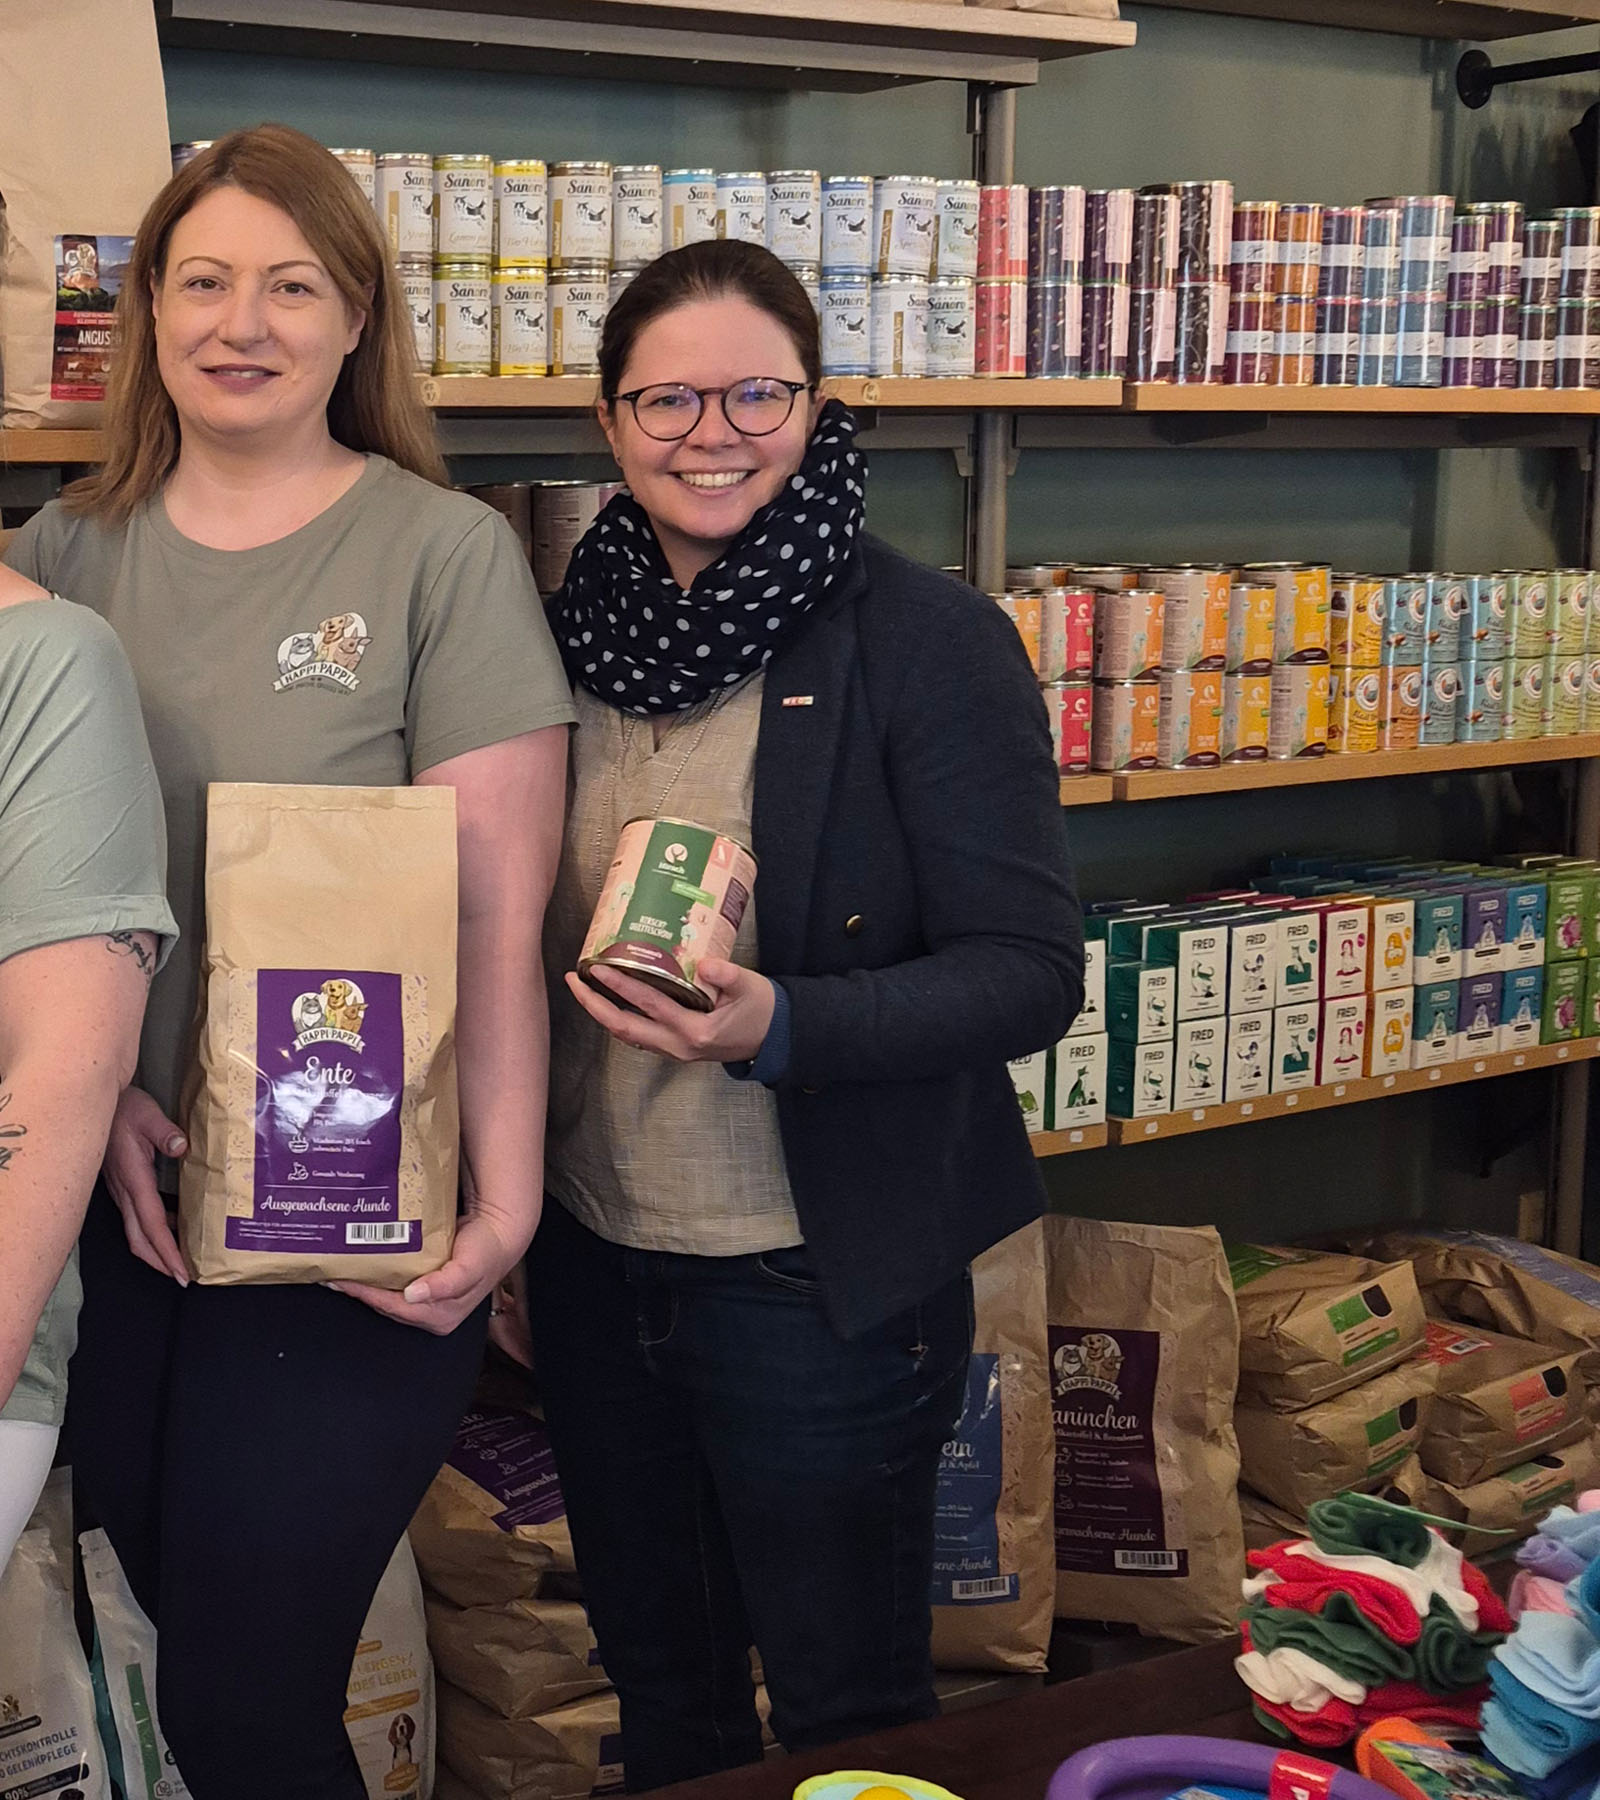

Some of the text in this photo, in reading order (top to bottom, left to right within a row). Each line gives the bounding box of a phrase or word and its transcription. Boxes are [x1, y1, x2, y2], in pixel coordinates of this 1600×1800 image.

[78, 330, 111, 346] ANGUS
[284, 663, 352, 684] HAPPI PAPPI
[1385, 912, 1406, 924] FRED
[1287, 925, 1309, 937] FRED
[1337, 919, 1358, 931] FRED
[1192, 938, 1216, 950] FRED
[1245, 934, 1267, 946] FRED
[1147, 977, 1167, 987] FRED
[1385, 998, 1406, 1011] FRED
[1336, 1006, 1358, 1019] FRED
[1287, 1014, 1309, 1026] FRED
[1239, 1021, 1262, 1033] FRED
[302, 1029, 358, 1045] HAPPI PAPPI
[1190, 1028, 1215, 1041] FRED
[1069, 1045, 1096, 1058] FRED
[1144, 1051, 1165, 1061] FRED
[304, 1055, 356, 1085] Ente
[260, 1195, 392, 1216] Ausgewachsene Hunde
[1051, 1402, 1138, 1430] aninchen
[1118, 1527, 1157, 1541] Hunde
[957, 1556, 992, 1570] Hunde
[6, 1743, 78, 1779] GELENKPFLEGE
[5, 1787, 30, 1800] 90%
